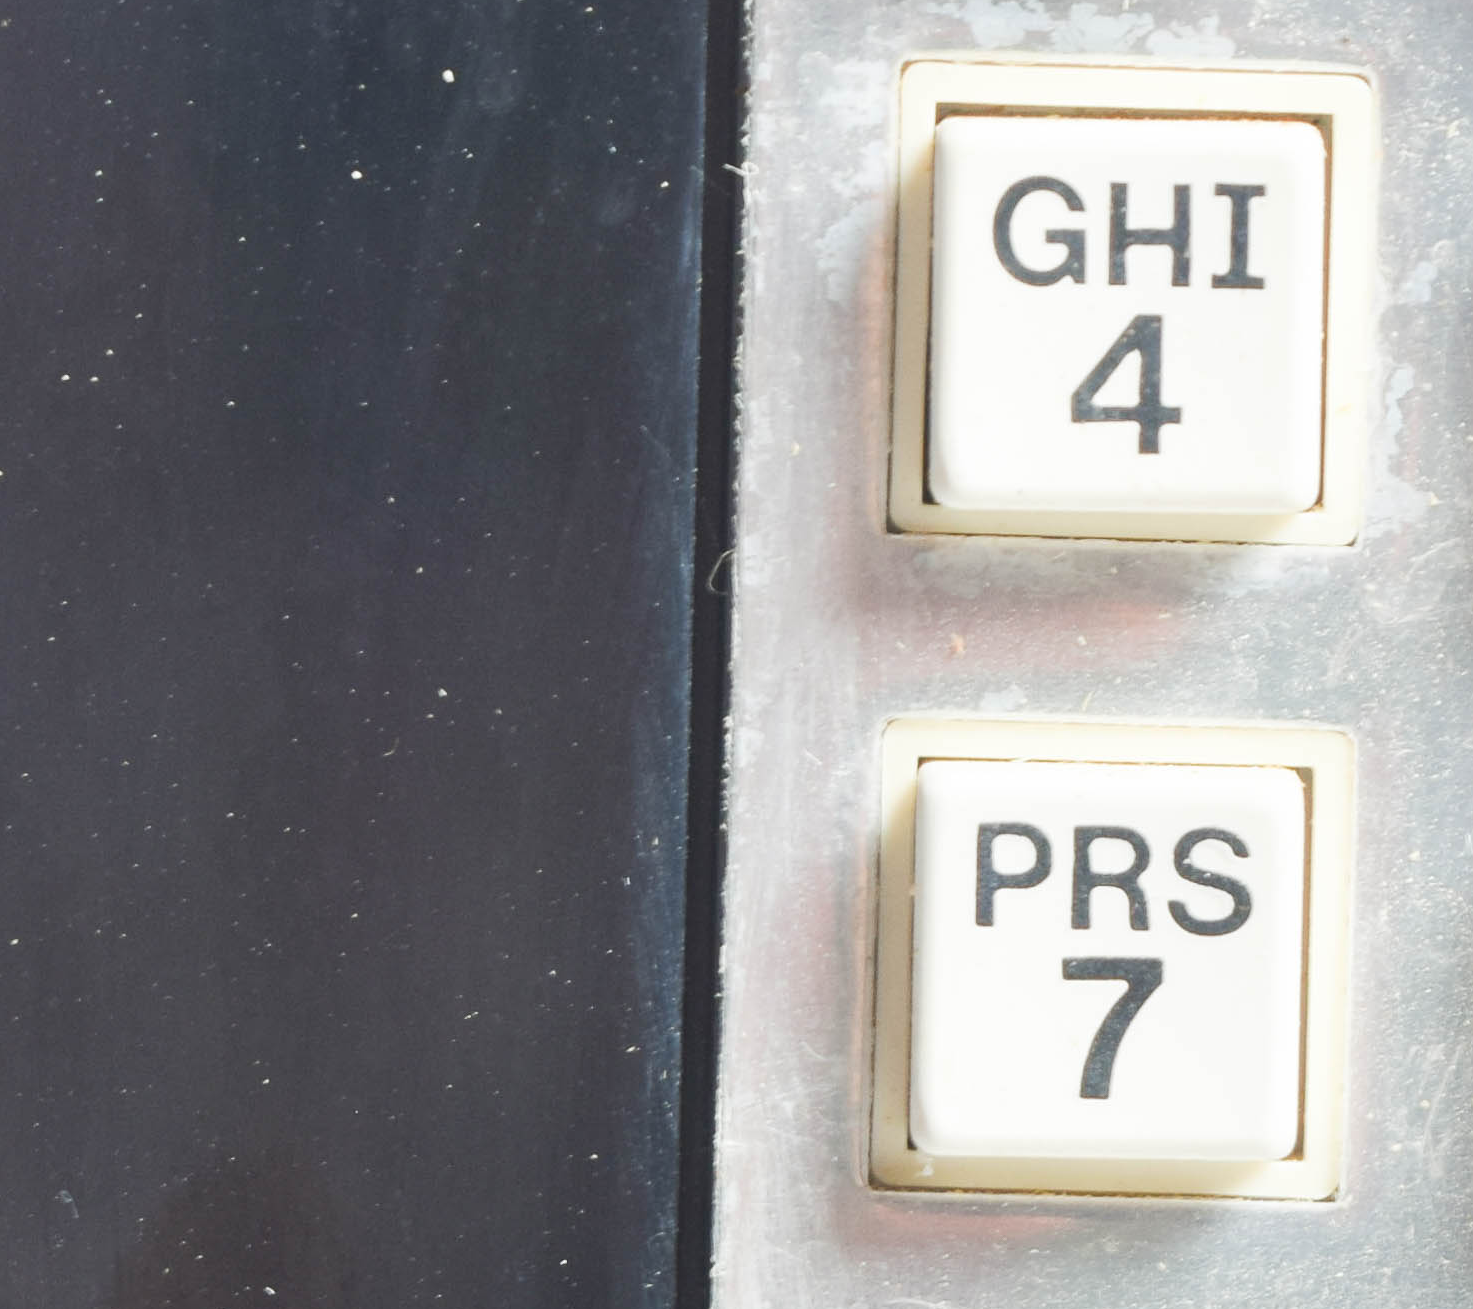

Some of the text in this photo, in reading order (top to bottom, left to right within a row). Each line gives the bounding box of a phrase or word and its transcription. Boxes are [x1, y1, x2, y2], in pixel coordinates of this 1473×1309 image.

[992, 176, 1266, 291] GHI
[1071, 314, 1182, 455] 4
[974, 822, 1253, 938] PRS
[1061, 957, 1164, 1101] 7
